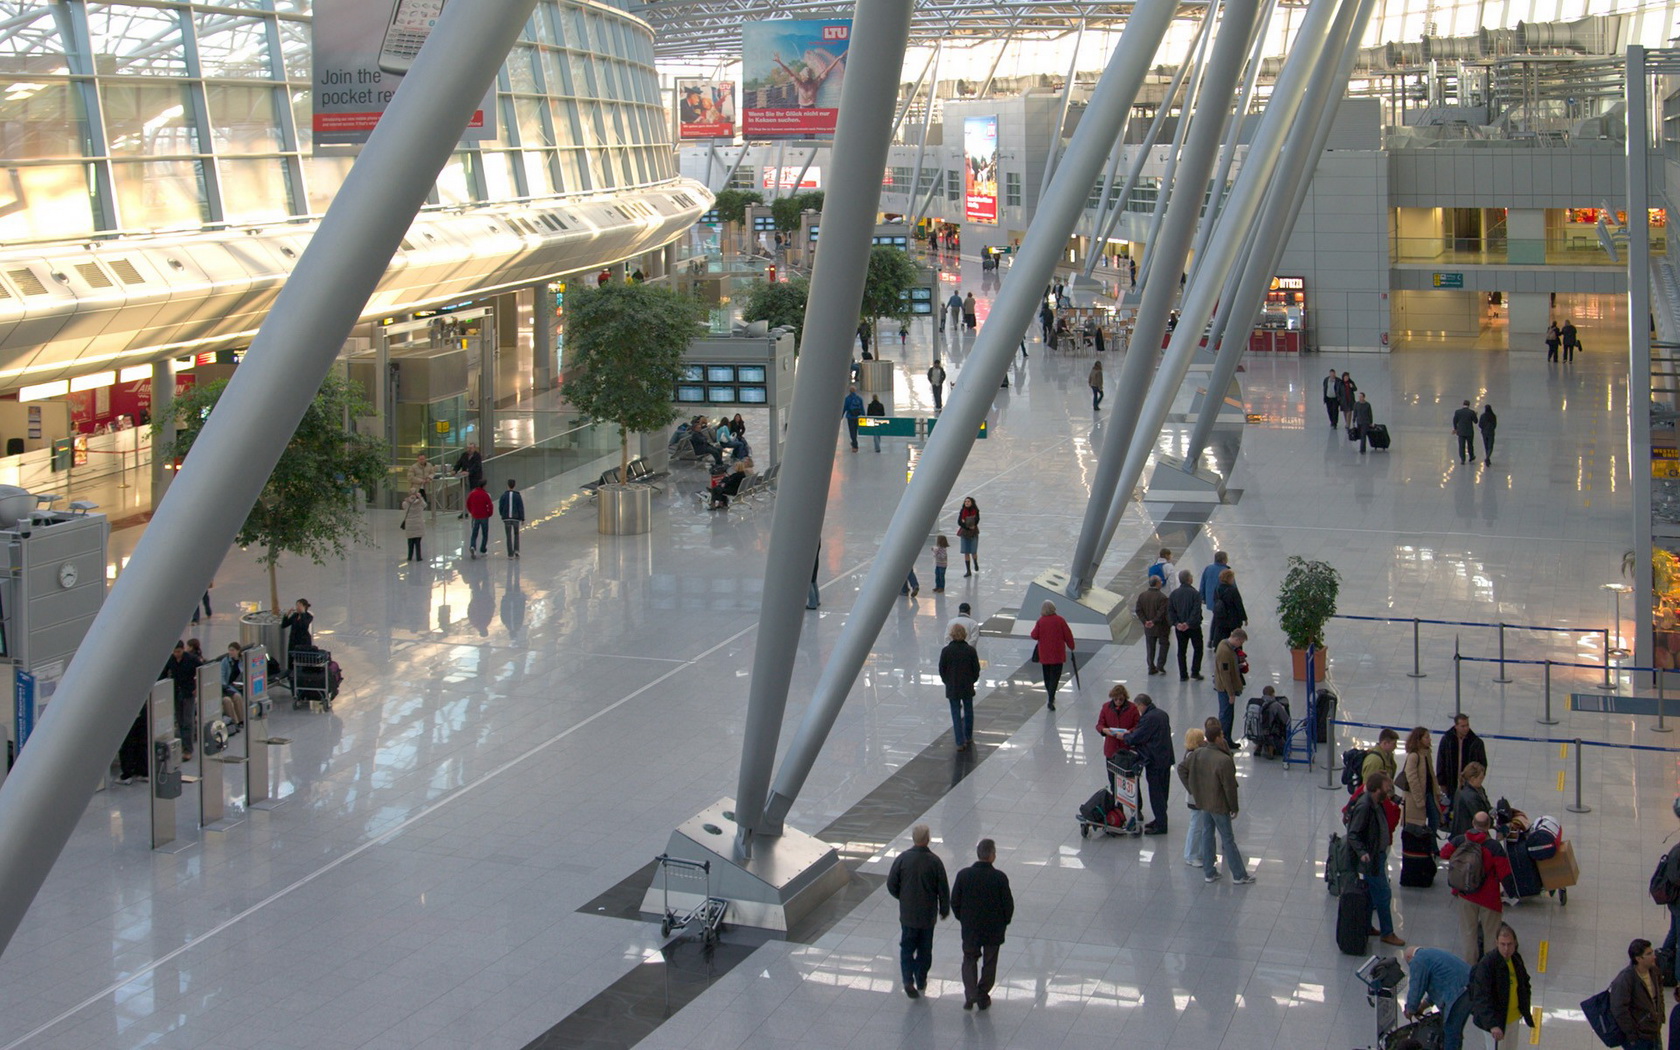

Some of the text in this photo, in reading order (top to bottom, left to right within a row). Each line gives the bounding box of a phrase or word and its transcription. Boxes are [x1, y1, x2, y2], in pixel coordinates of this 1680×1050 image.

[824, 27, 848, 39] LTU
[321, 68, 382, 85] Join the
[322, 88, 396, 108] pocket re
